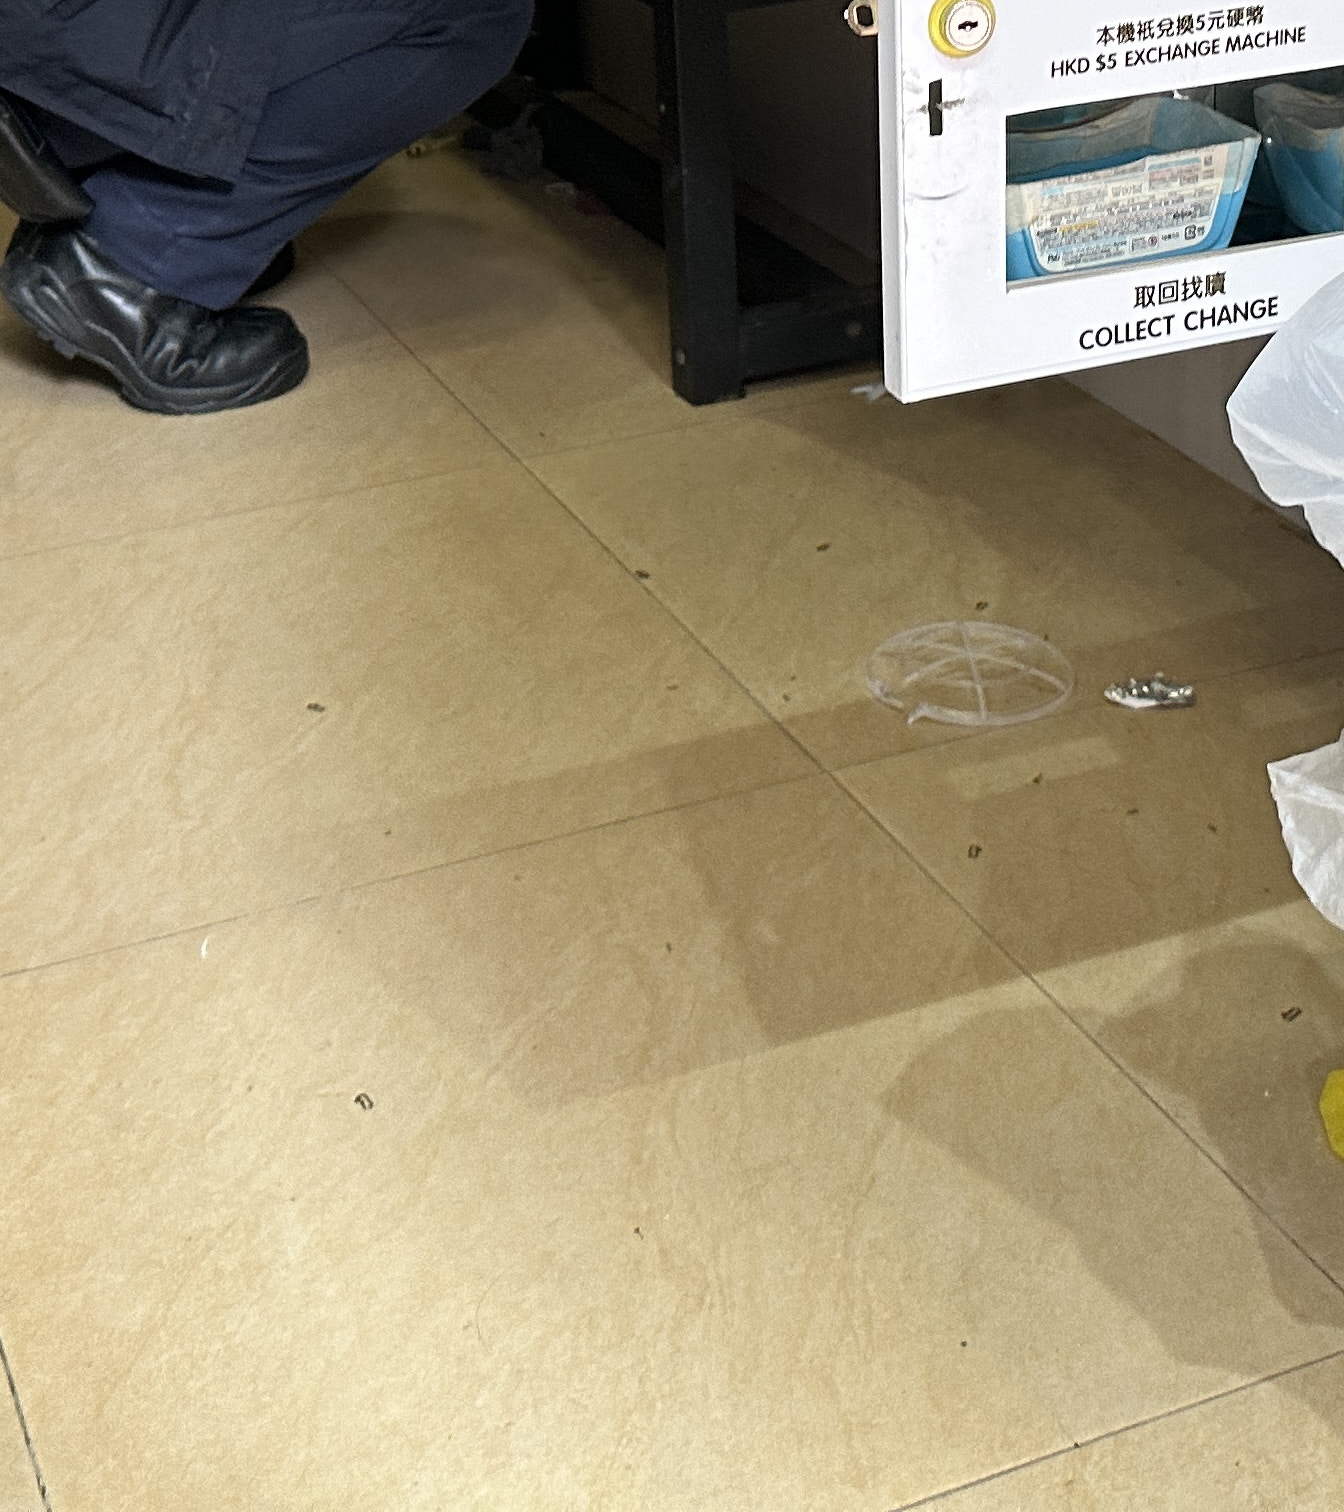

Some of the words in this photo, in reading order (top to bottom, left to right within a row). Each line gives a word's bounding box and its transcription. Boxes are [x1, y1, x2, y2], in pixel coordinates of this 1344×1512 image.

[1050, 56, 1090, 79] HKD
[1096, 52, 1117, 73] $5
[1125, 37, 1220, 68] EXCHANGE
[1225, 25, 1307, 54] MACHINE
[1079, 314, 1175, 350] COLLECT
[1184, 296, 1278, 331] CHANGE
